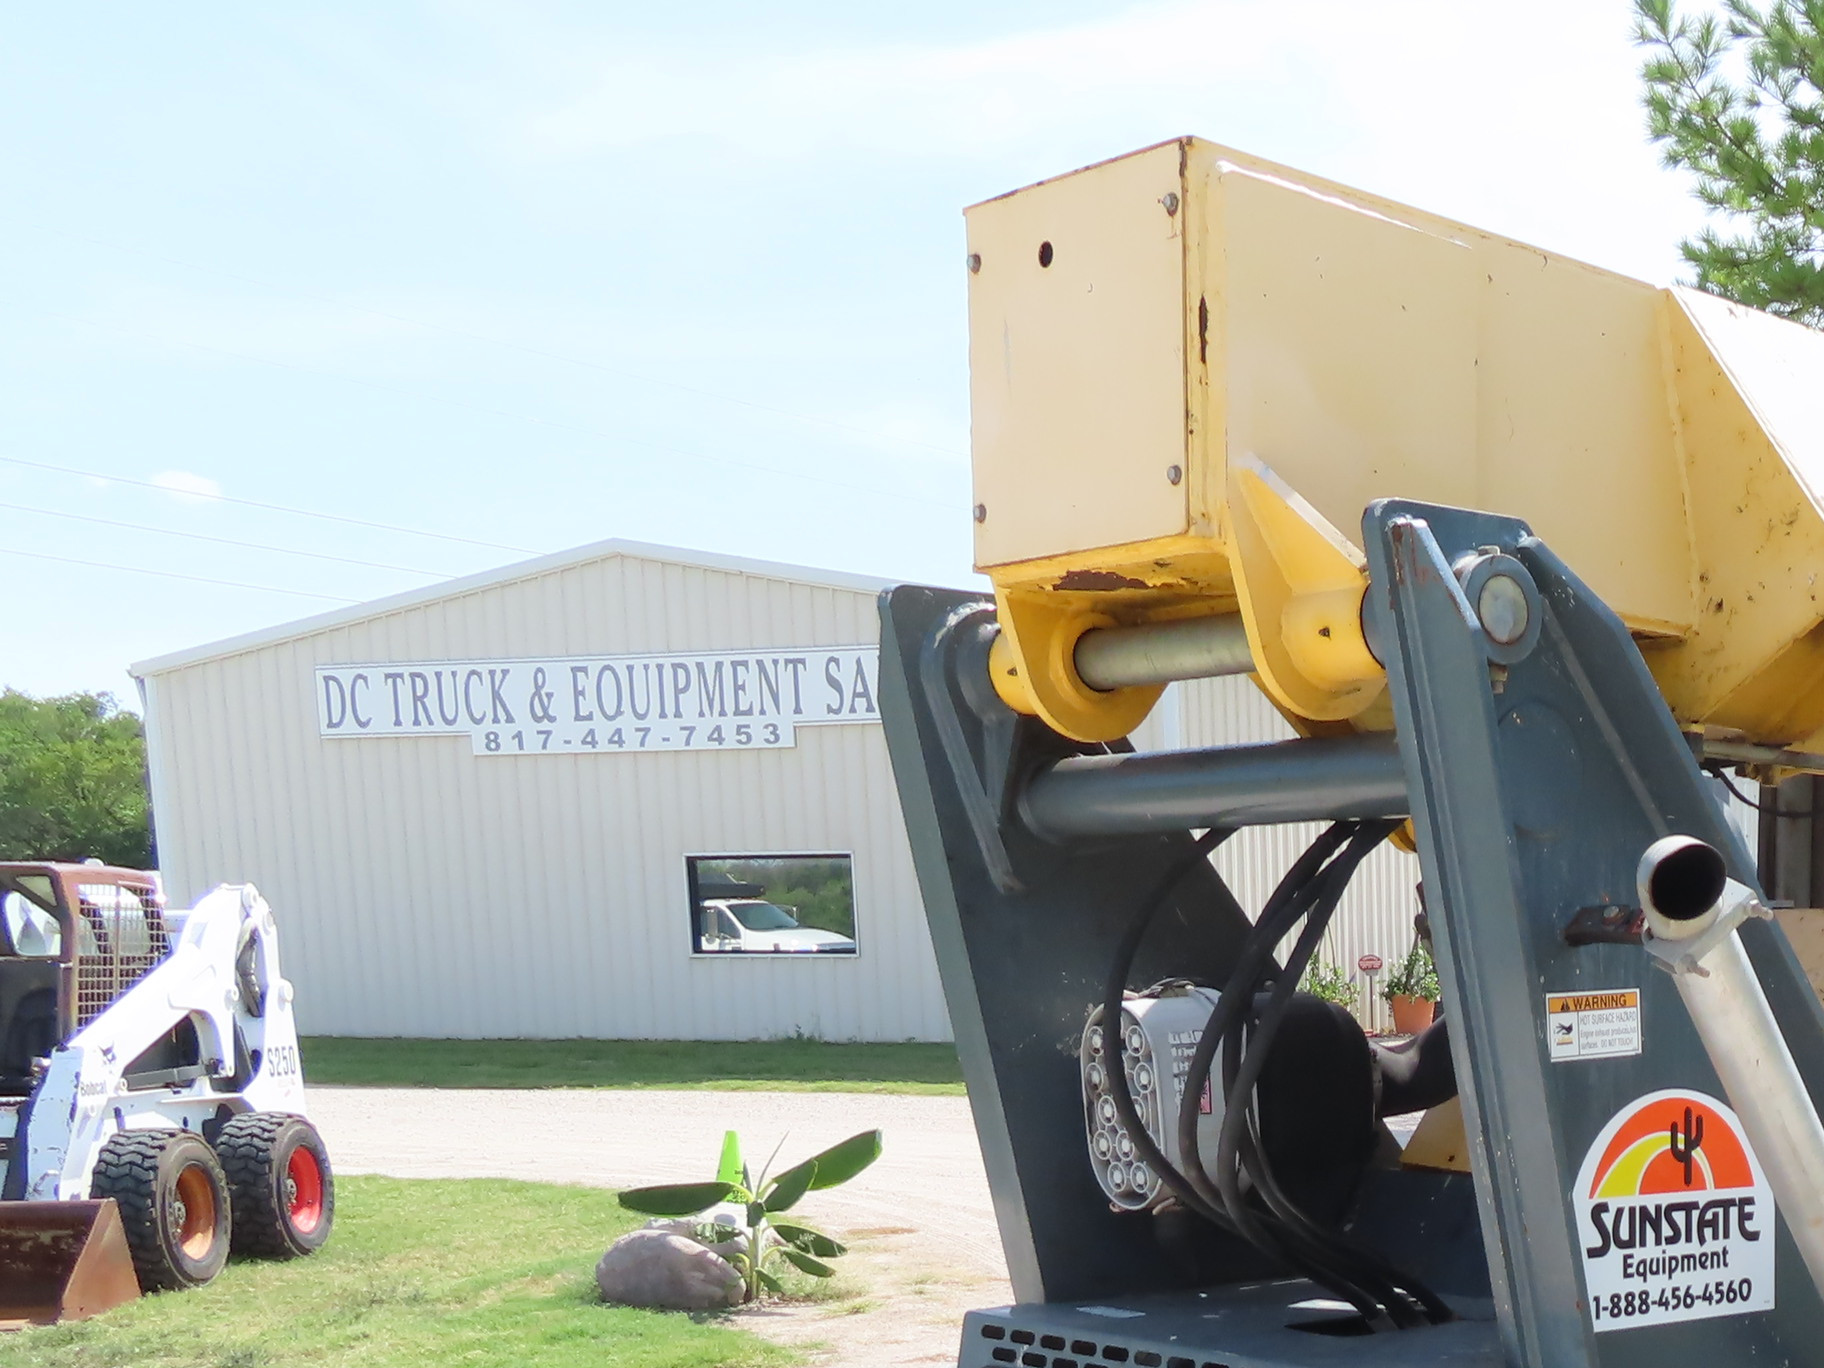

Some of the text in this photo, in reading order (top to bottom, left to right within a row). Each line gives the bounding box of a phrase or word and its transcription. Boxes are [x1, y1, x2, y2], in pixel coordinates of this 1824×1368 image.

[322, 673, 373, 729] DC
[384, 668, 516, 727] TRUCK
[529, 666, 557, 724] &
[570, 657, 807, 722] EQUIPMENT
[484, 722, 781, 752] 817-447-7453
[1573, 994, 1627, 1010] WARNING
[267, 1045, 297, 1077] S250
[80, 1079, 108, 1097] Bobcat
[1586, 1196, 1762, 1260] SUNSTATE
[1622, 1245, 1730, 1284] Equipment
[1592, 1277, 1753, 1321] 1-888-456-4560
